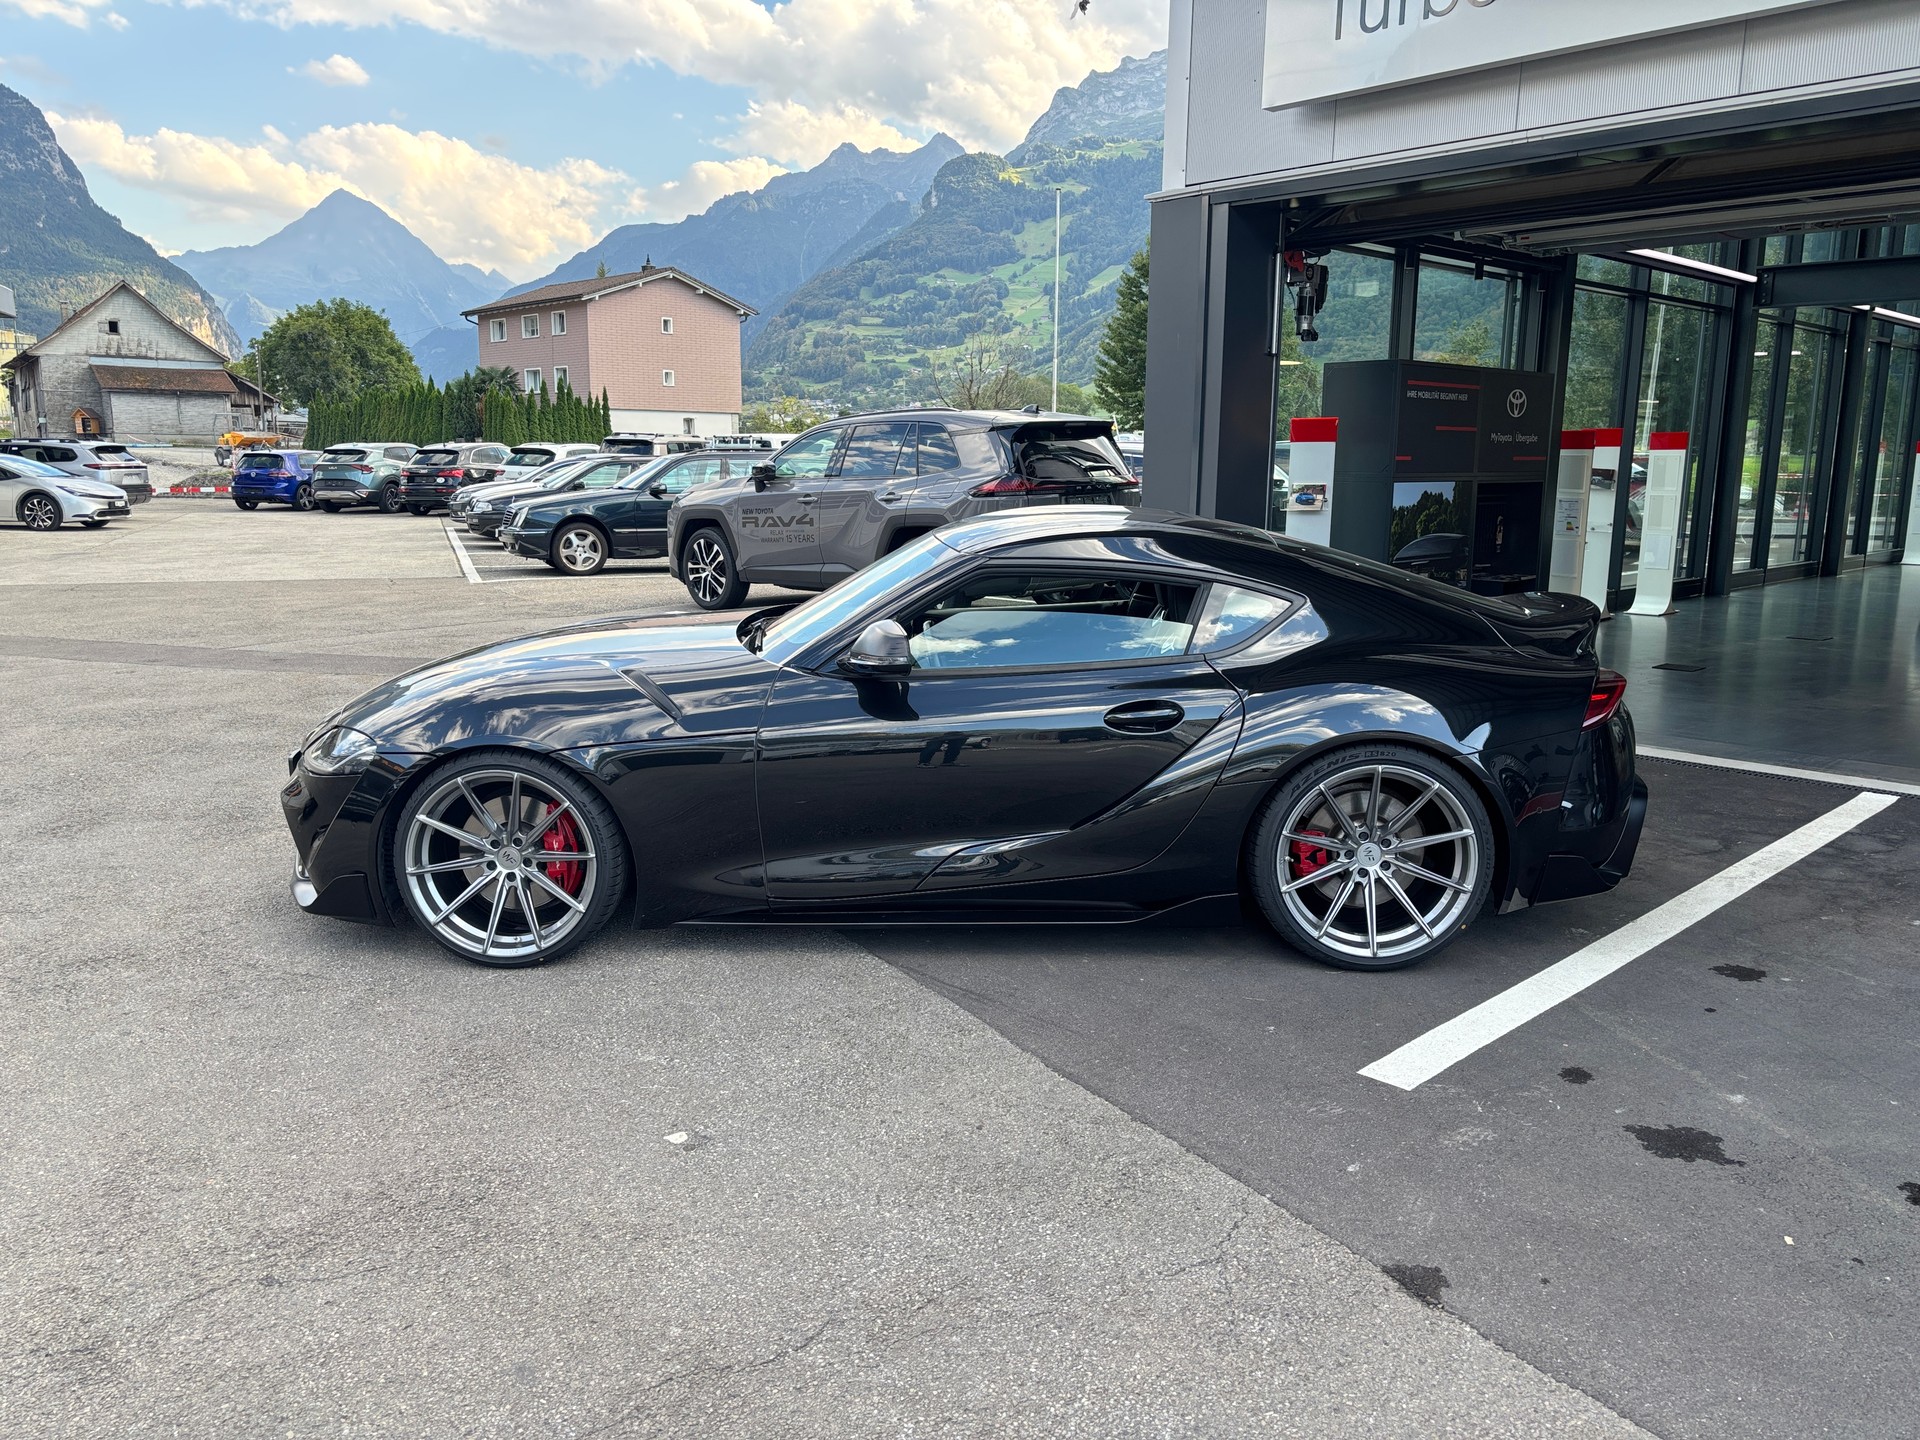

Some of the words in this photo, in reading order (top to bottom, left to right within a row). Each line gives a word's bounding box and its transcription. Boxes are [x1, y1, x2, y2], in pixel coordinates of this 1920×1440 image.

[1407, 390, 1418, 398] IHRE
[1491, 432, 1513, 443] MyToyota
[1515, 431, 1538, 444] Übergabe
[742, 513, 814, 528] RAV4
[786, 534, 793, 543] 15
[793, 534, 815, 543] YEARS
[1289, 752, 1362, 799] AZENIS
